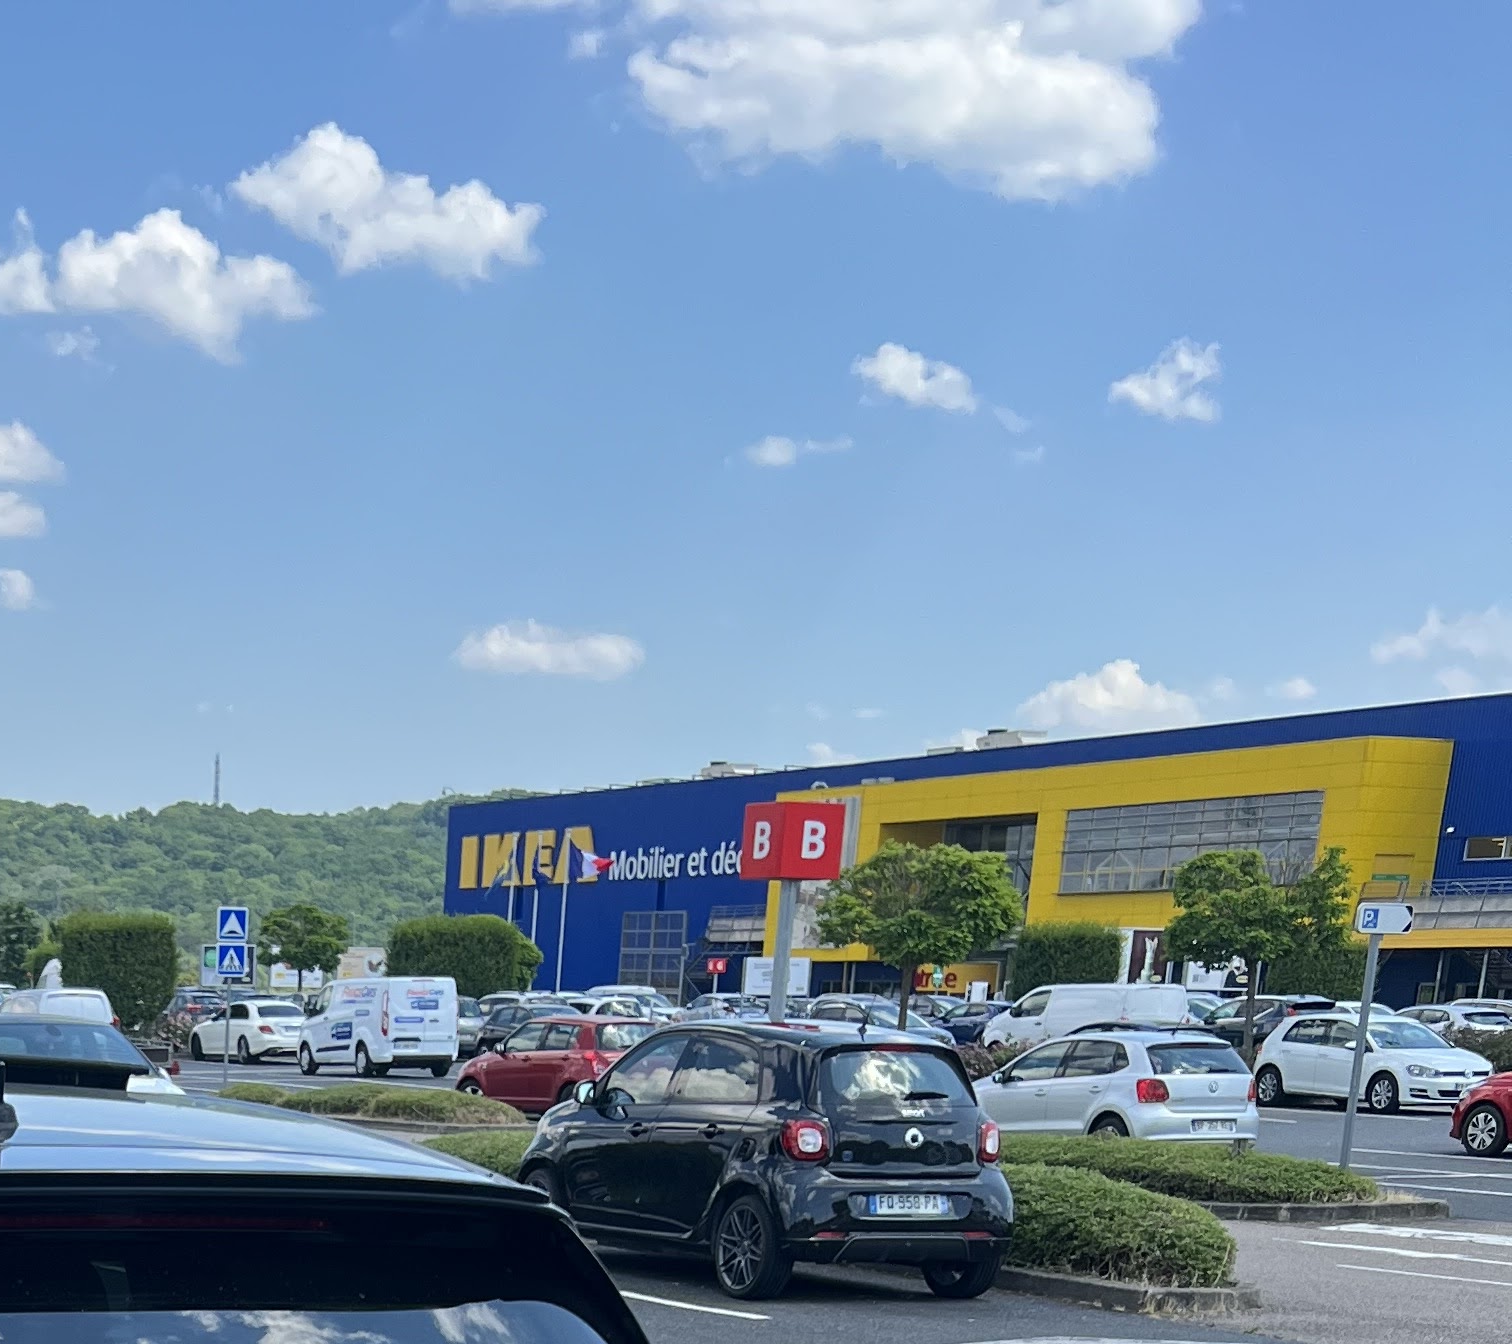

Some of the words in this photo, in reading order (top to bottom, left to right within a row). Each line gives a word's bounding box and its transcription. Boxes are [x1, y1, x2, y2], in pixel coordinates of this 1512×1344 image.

[459, 826, 598, 889] IKEA
[753, 821, 771, 860] B
[801, 820, 826, 859] B
[609, 846, 682, 881] Mobilier
[688, 848, 707, 877] et
[1363, 910, 1375, 926] P
